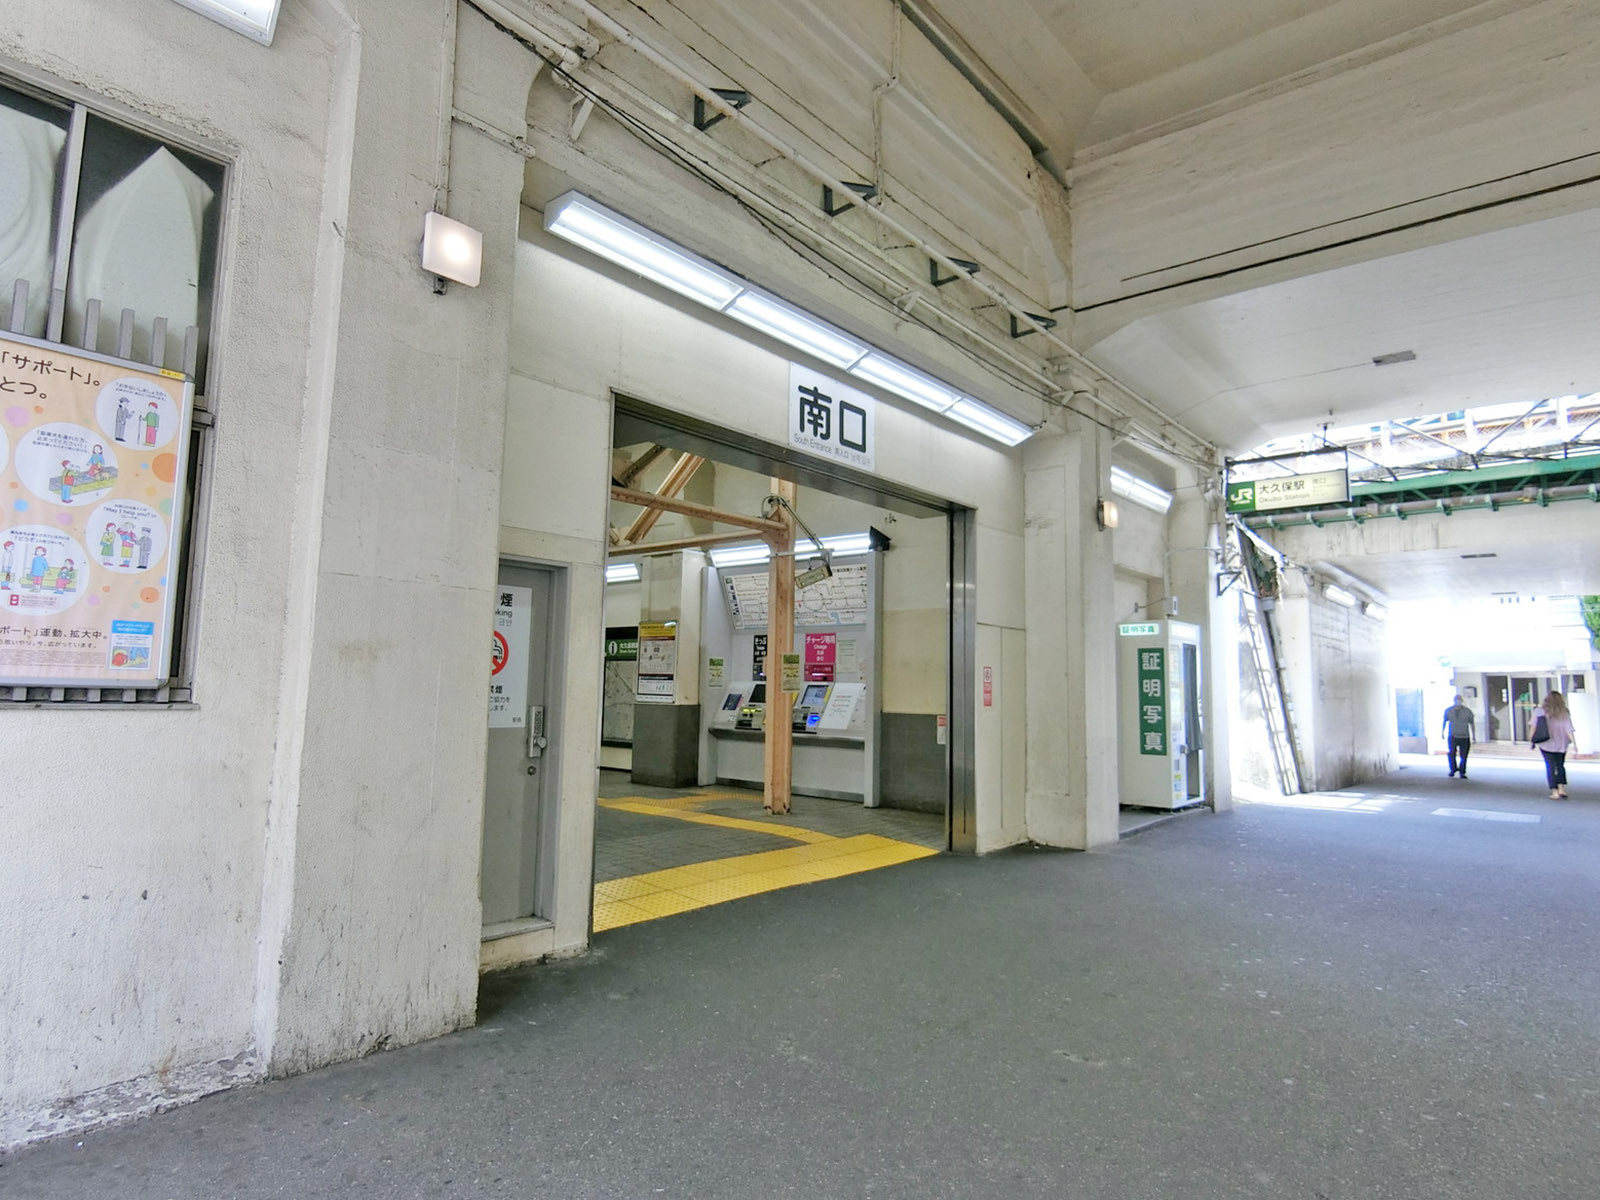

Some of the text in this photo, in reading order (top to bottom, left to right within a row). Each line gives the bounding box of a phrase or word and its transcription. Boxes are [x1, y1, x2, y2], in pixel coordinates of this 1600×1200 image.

[2, 351, 100, 387] 「サポート」。
[0, 376, 47, 399] とつ。
[798, 385, 867, 453] 南口
[793, 433, 809, 448] South
[810, 439, 833, 454] Entrance
[1230, 487, 1253, 502] JR
[1259, 480, 1305, 494] 大久保駅
[1259, 495, 1282, 503] Okubo
[1284, 492, 1310, 501] Station
[1141, 652, 1164, 751] 証明写真
